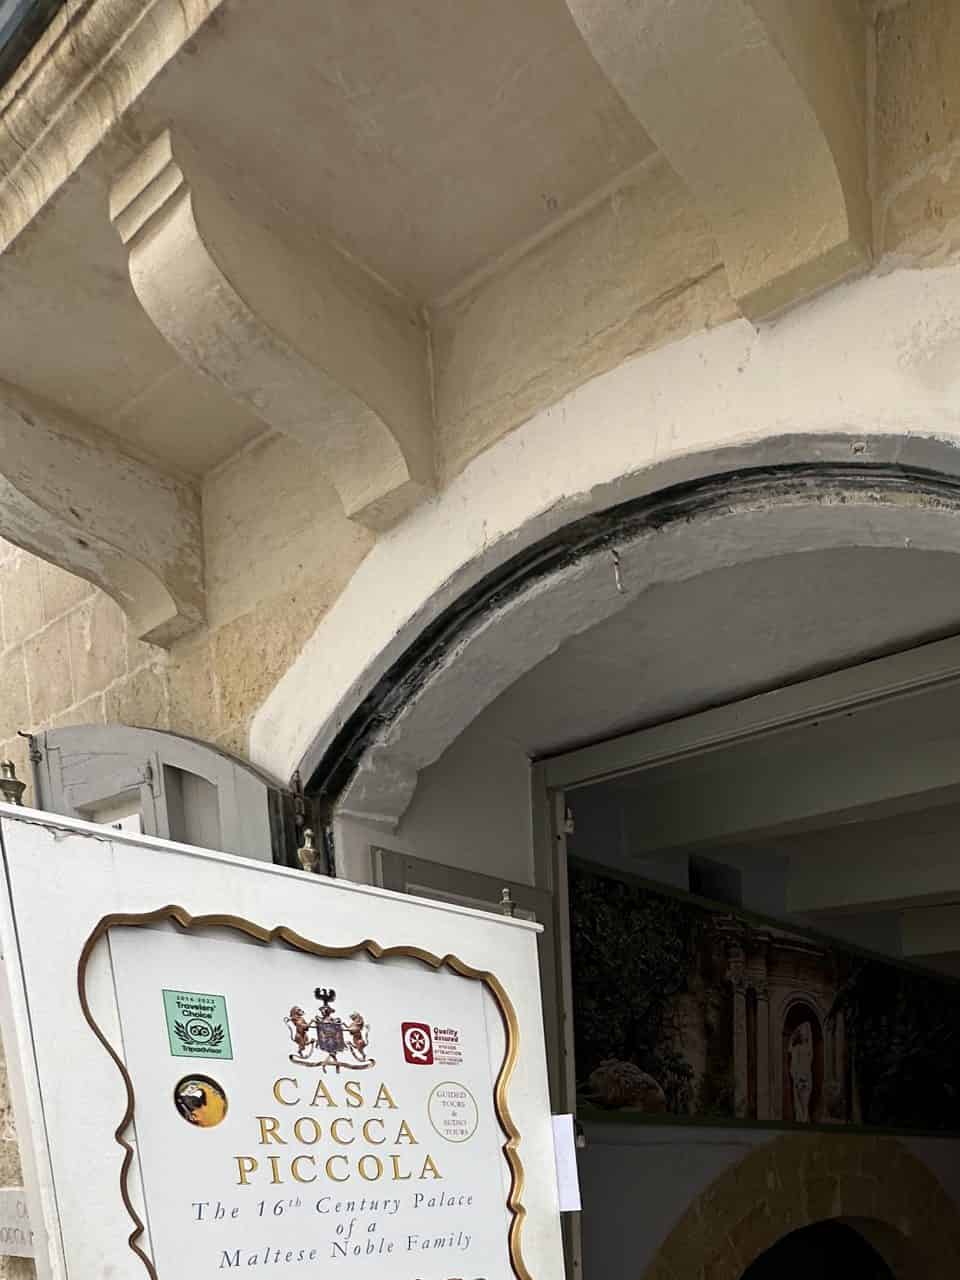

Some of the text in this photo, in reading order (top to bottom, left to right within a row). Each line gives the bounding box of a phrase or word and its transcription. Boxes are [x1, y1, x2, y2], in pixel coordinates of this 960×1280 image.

[272, 1077, 400, 1110] CASA
[255, 1115, 420, 1146] ROCCA
[233, 1154, 443, 1186] PICCOLA
[192, 1202, 240, 1222] The
[316, 1196, 401, 1216] Century
[414, 1191, 474, 1209] Palace
[335, 1217, 377, 1238] of a
[219, 1230, 473, 1270] Maltese Noble Family
